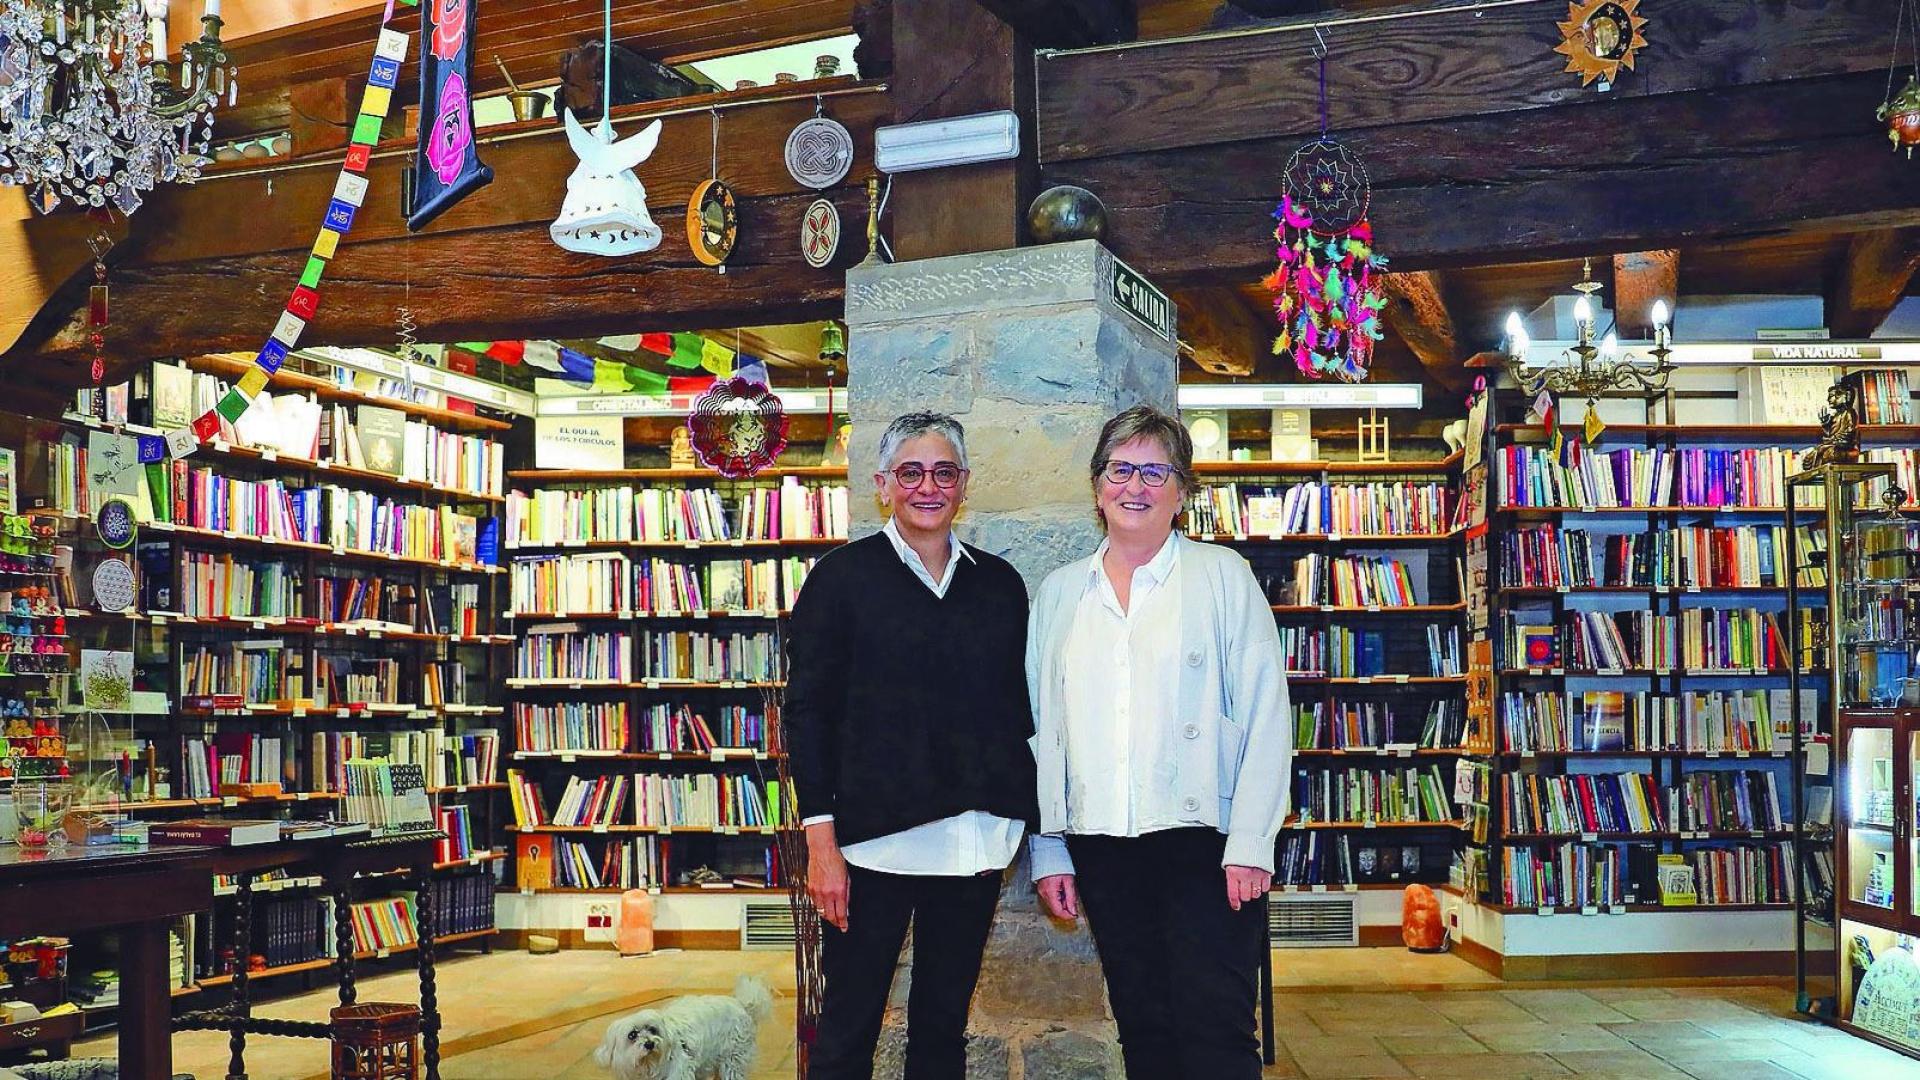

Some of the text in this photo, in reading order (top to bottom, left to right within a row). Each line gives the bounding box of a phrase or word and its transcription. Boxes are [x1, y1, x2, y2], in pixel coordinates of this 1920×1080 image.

[1132, 282, 1166, 329] SALIDA
[1772, 346, 1862, 359] VIDA NATURAL
